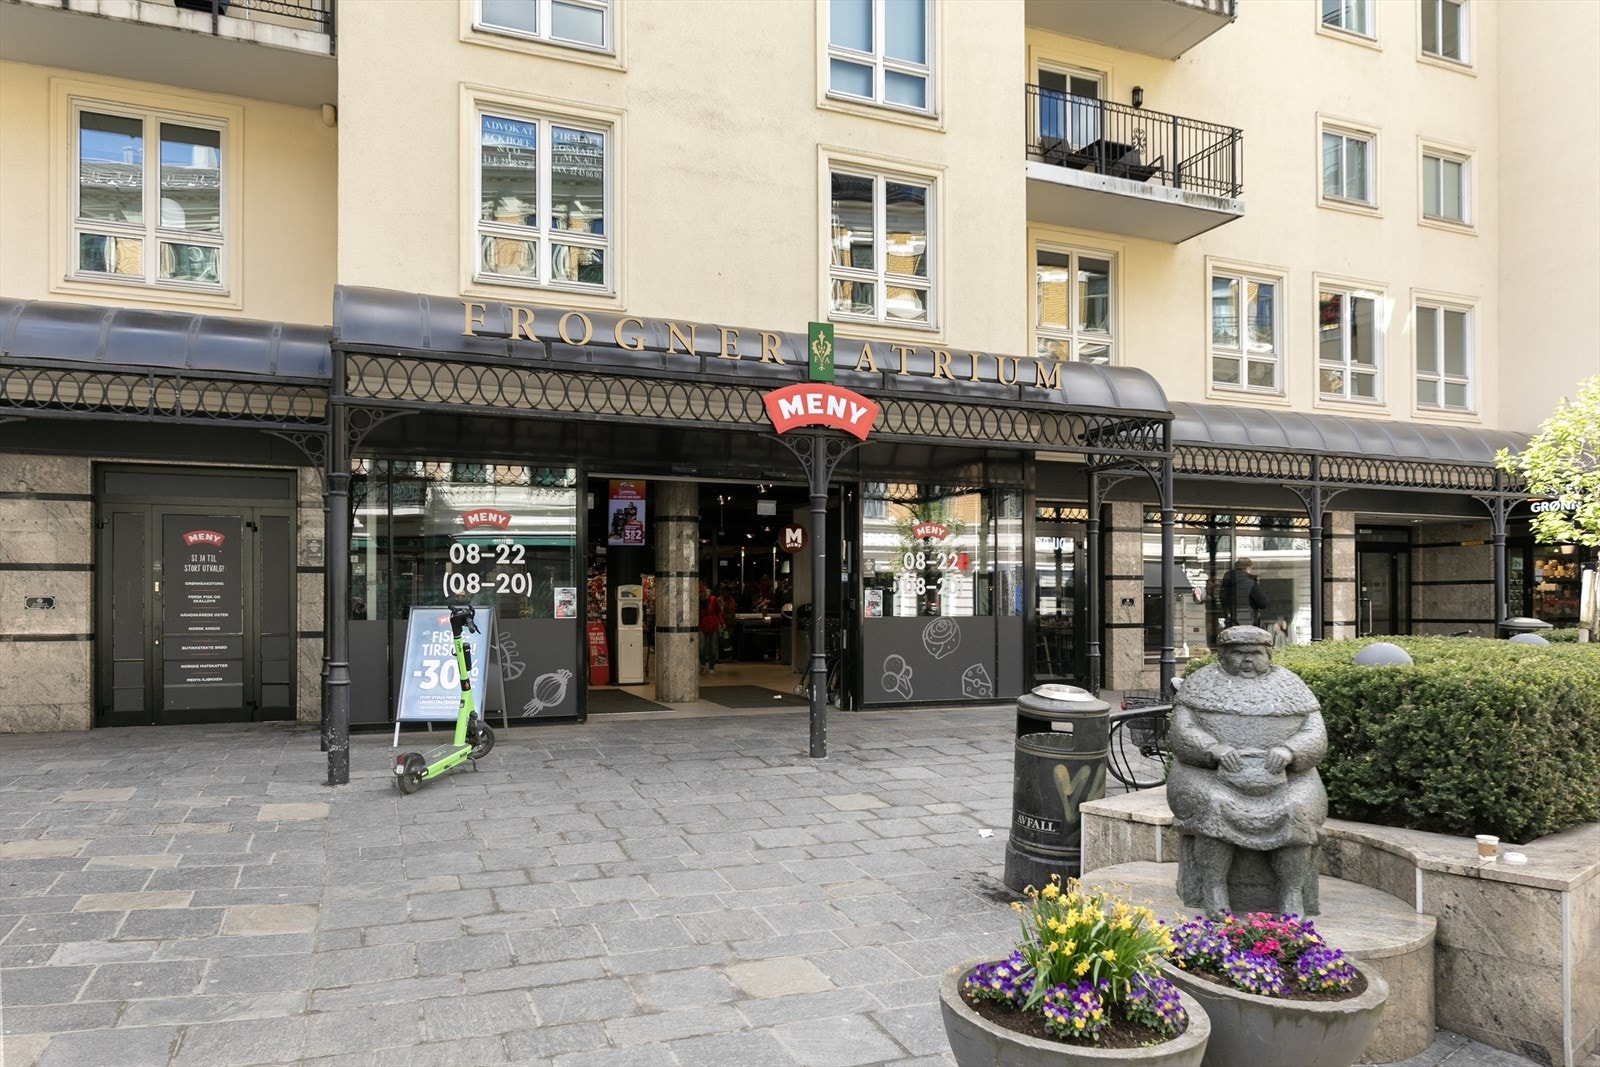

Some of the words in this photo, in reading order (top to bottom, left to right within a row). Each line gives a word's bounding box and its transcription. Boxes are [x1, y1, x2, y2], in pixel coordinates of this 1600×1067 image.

[485, 121, 533, 135] ADVOKAT
[461, 302, 786, 365] FROGNER
[854, 343, 1064, 391] ATRIUM
[777, 393, 868, 425] MENY
[467, 512, 507, 524] MENY
[188, 533, 222, 543] MENY
[916, 525, 945, 536] MENY
[191, 554, 198, 563] SI
[199, 554, 206, 562] JA
[207, 554, 217, 563] TIL
[449, 543, 526, 564] 08-22
[903, 552, 959, 570] 08-22
[184, 564, 201, 573] STORT
[202, 564, 225, 573] UTVALG!
[443, 572, 533, 598] (08-20)
[1017, 815, 1056, 832] AVFALL
